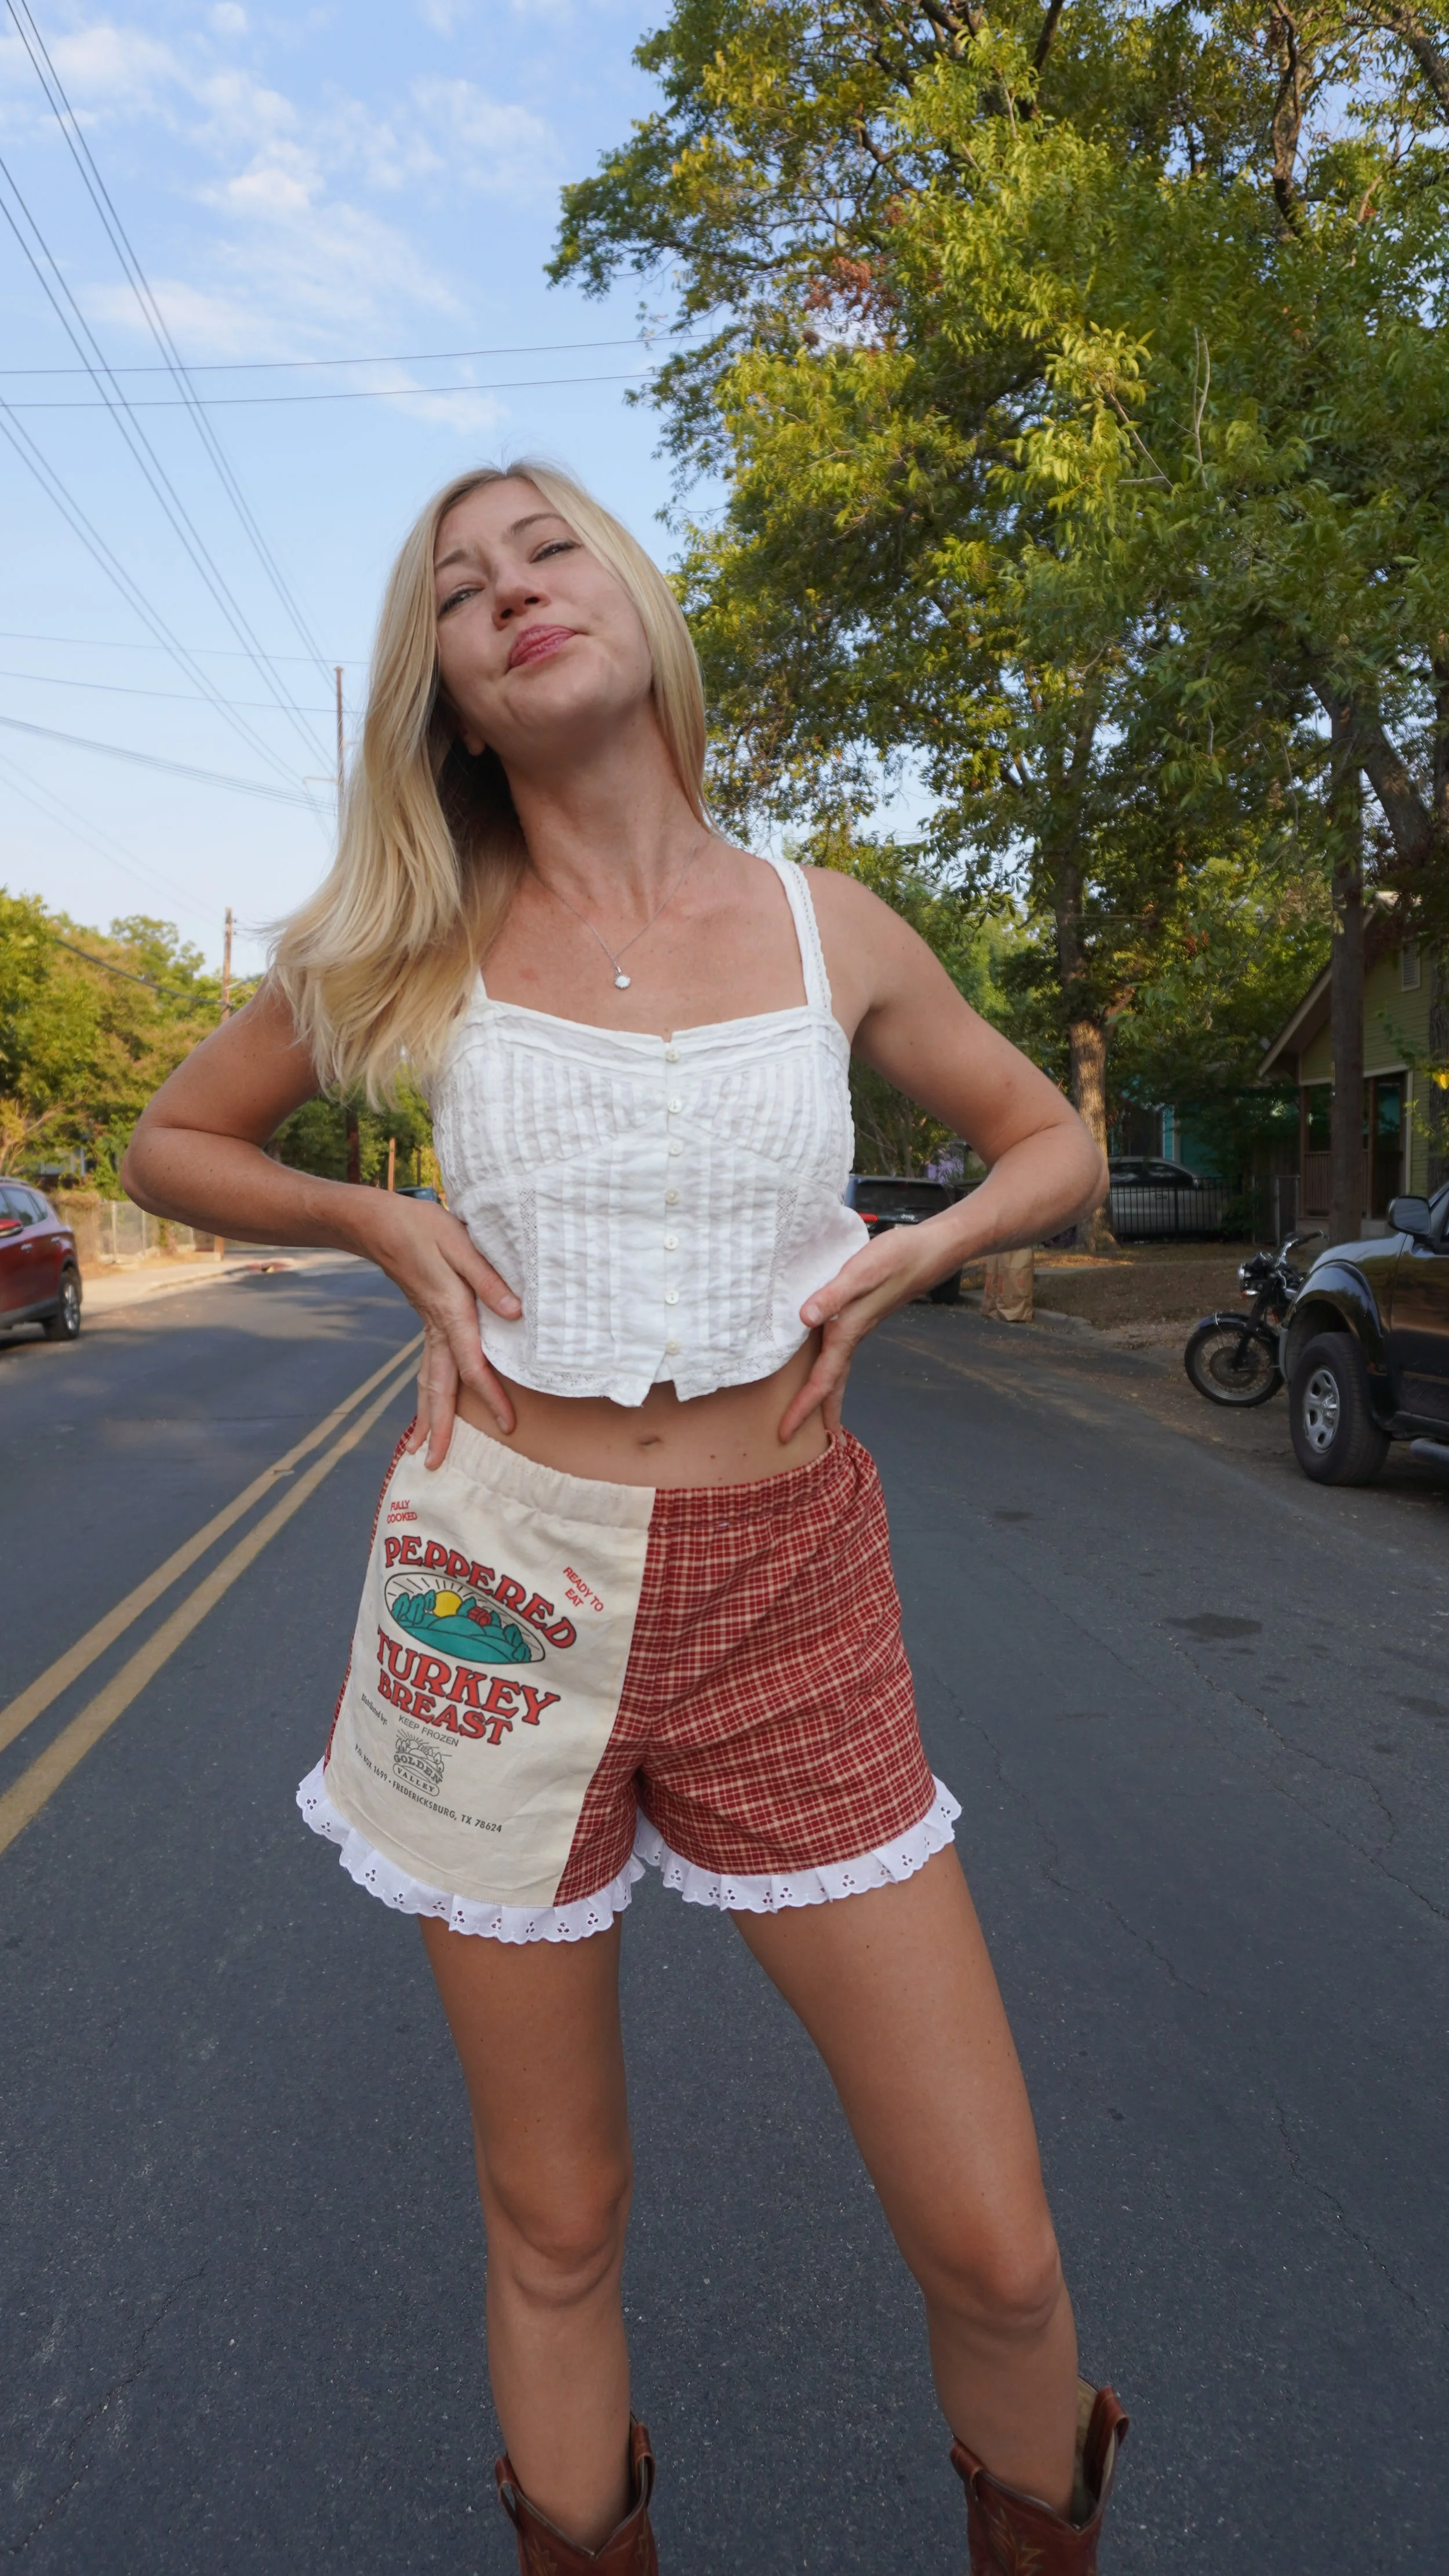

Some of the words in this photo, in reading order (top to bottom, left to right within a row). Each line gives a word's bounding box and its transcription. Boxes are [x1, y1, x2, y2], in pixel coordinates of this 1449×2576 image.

[387, 1512, 417, 1524] COOKED
[391, 1499, 410, 1511] FULLY
[385, 1535, 577, 1649] PEPPERED
[563, 1567, 593, 1597] READY
[591, 1596, 603, 1612] TO
[565, 1588, 584, 1607] EAT
[377, 1624, 560, 1725] TURKEY
[378, 1668, 513, 1745] BREAST
[399, 1714, 420, 1730] KEEP
[421, 1727, 459, 1746] FROZEN
[394, 1754, 442, 1784] GOLDEN
[398, 1767, 435, 1792] VALLEY
[363, 1754, 372, 1770] BOX
[374, 1765, 387, 1781] 1699
[392, 1780, 457, 1821] FREDERICKSBURG,
[461, 1814, 472, 1825] TX
[475, 1819, 503, 1833] 78624
